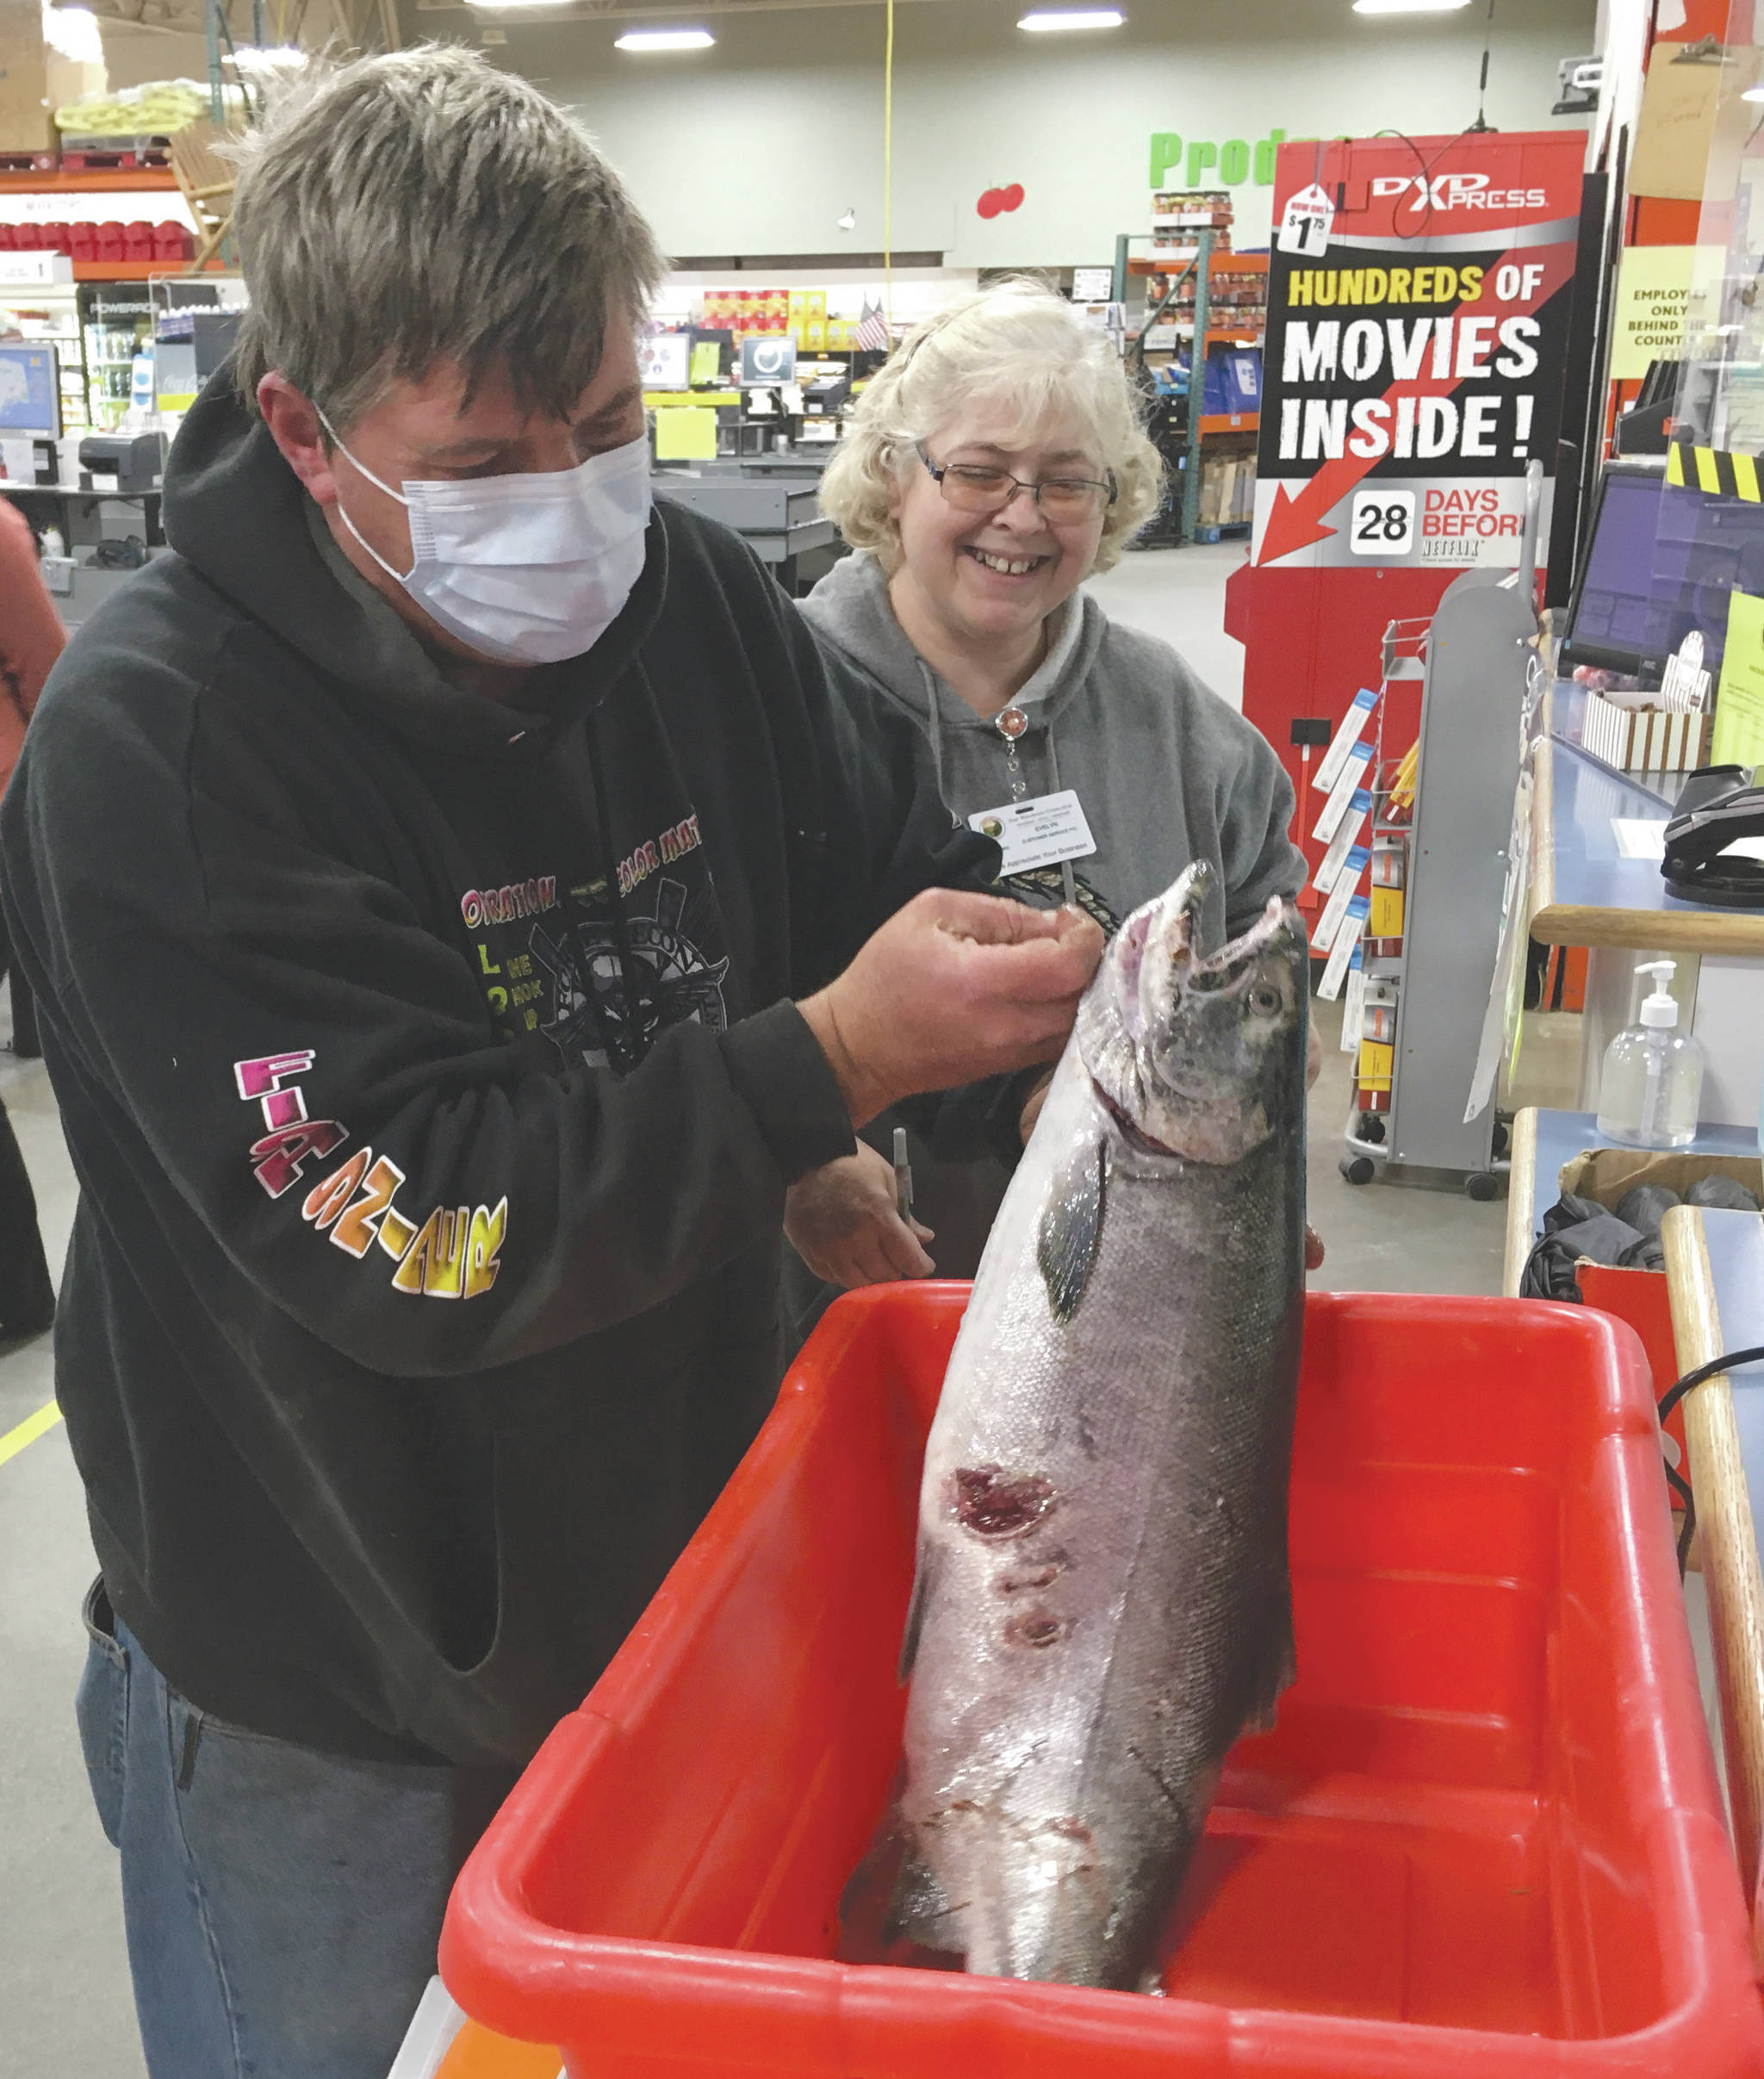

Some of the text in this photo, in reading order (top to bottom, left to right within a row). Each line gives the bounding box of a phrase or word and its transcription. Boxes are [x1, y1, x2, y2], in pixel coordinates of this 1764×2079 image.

[1150, 128, 1285, 189] Prod
[1288, 264, 1544, 307] HUNDREDS OF
[1633, 289, 1706, 301] EMPLOY
[1651, 305, 1688, 316] ONLY
[1628, 320, 1679, 332] BEHIND
[1634, 335, 1688, 346] COUNT
[1282, 316, 1540, 383] MOVIES
[1425, 488, 1499, 512] DAYS
[1357, 505, 1407, 541] 28
[1421, 541, 1480, 557] NETFLIX
[1034, 822, 1059, 832] EVELYN
